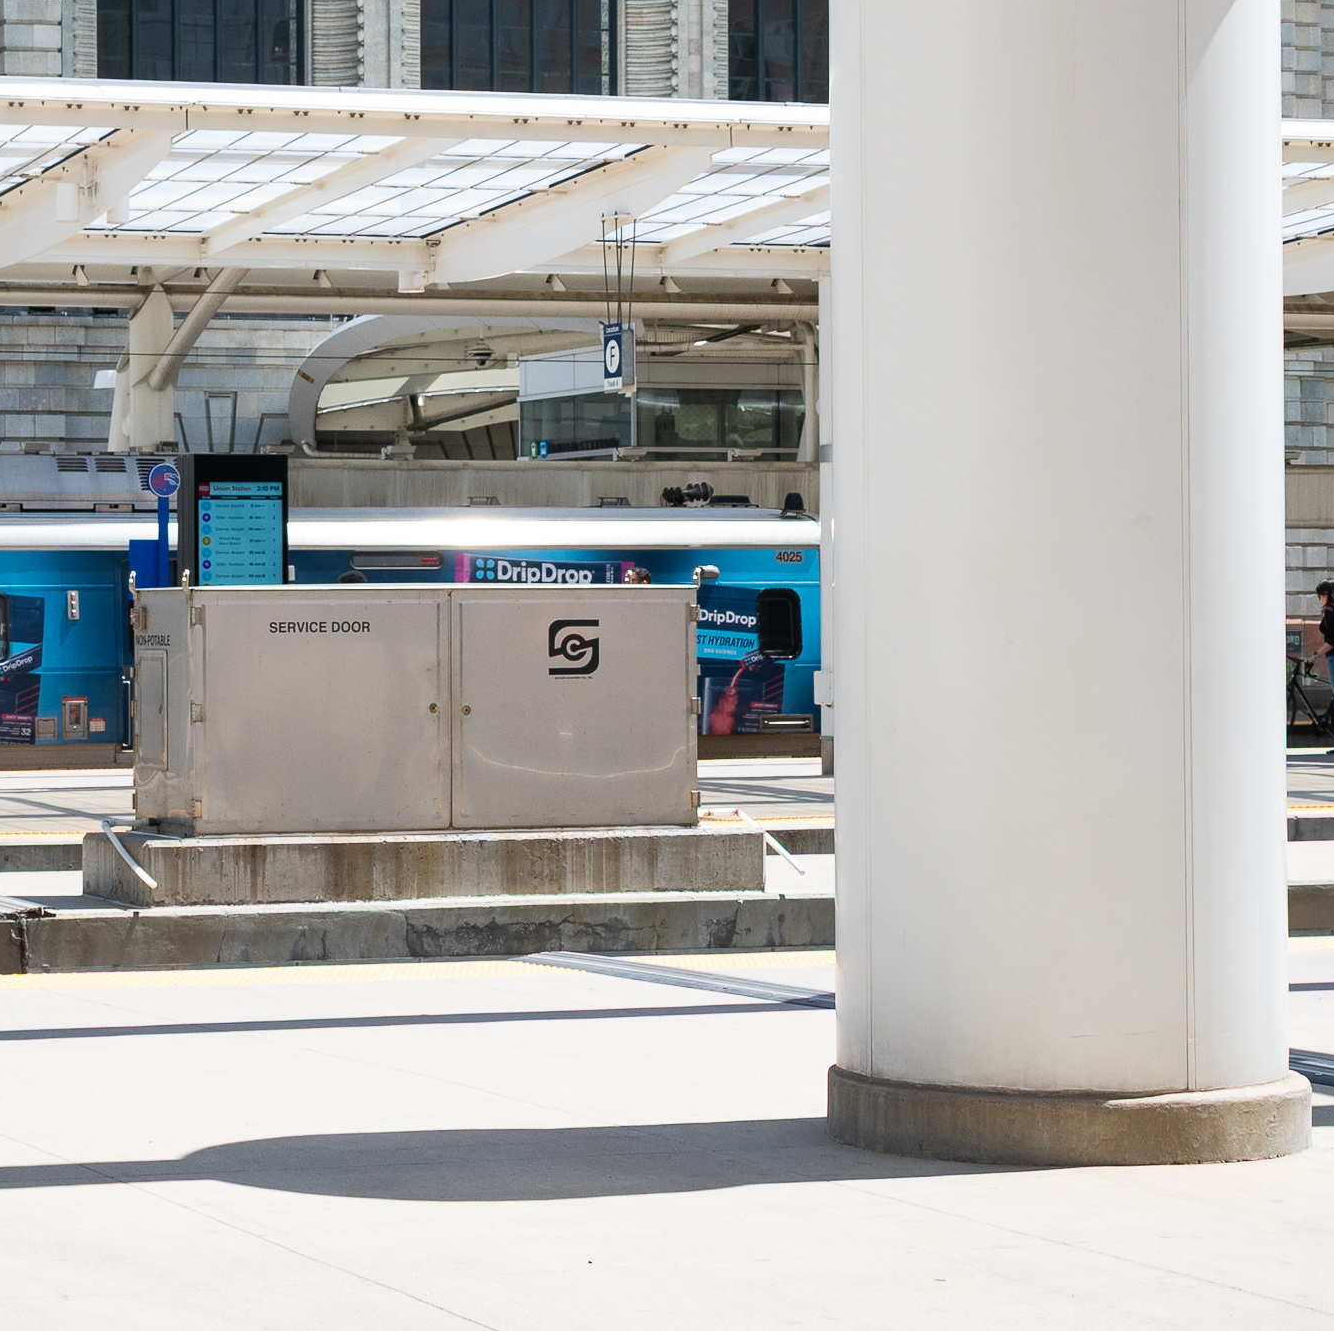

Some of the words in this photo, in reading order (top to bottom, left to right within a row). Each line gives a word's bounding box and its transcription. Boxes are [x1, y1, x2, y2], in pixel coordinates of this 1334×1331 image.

[610, 346, 616, 367] F
[776, 551, 802, 563] 4025
[497, 560, 593, 584] DripDrop
[699, 609, 757, 628] DripDrop
[269, 621, 327, 633] SERVICE
[331, 621, 371, 633] DOOR
[135, 635, 170, 647] NON-POTABLE
[697, 634, 708, 644] ST
[707, 635, 755, 649] HYDRATION
[20, 727, 32, 736] 32
